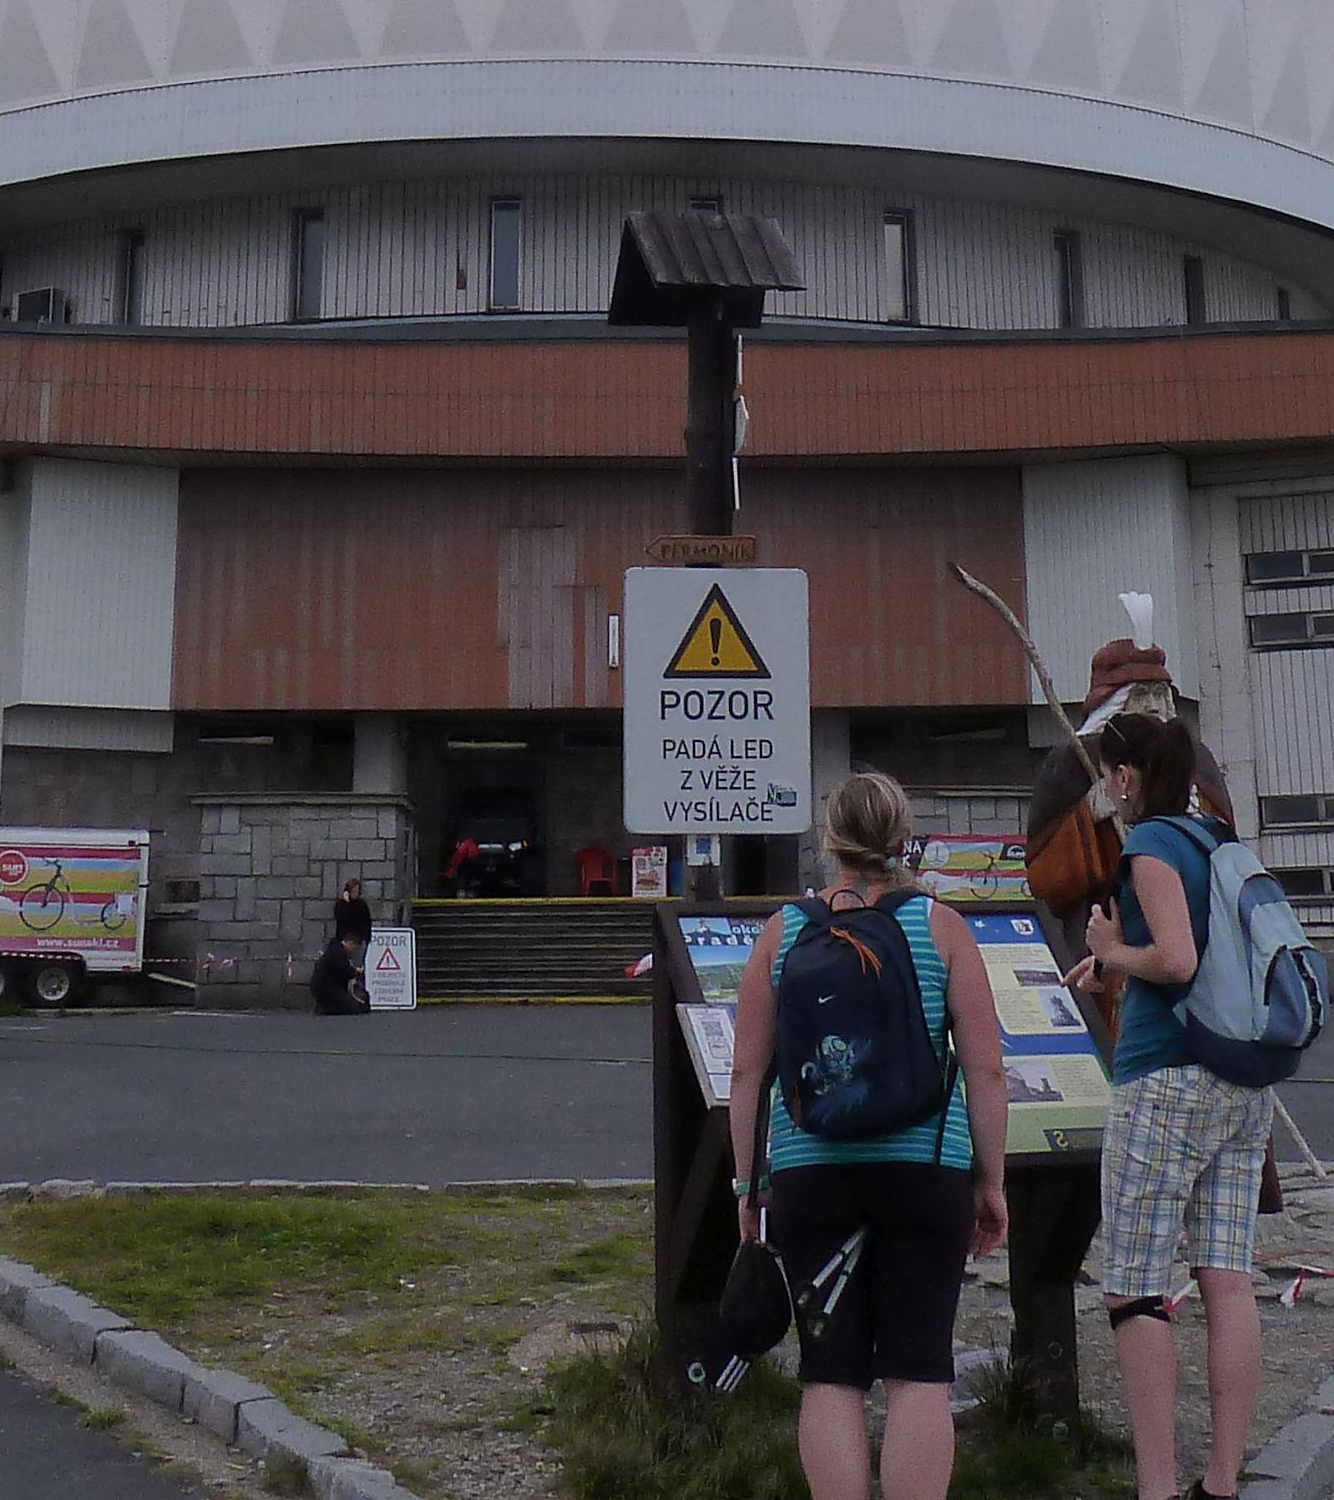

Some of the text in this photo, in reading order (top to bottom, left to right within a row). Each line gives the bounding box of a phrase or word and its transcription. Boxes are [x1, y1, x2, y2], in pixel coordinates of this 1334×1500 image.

[660, 690, 775, 720] POZOR
[662, 734, 774, 759] PADÁ LED
[680, 765, 756, 790] Z VĚŽE
[663, 796, 774, 822] VYSÍLAČE
